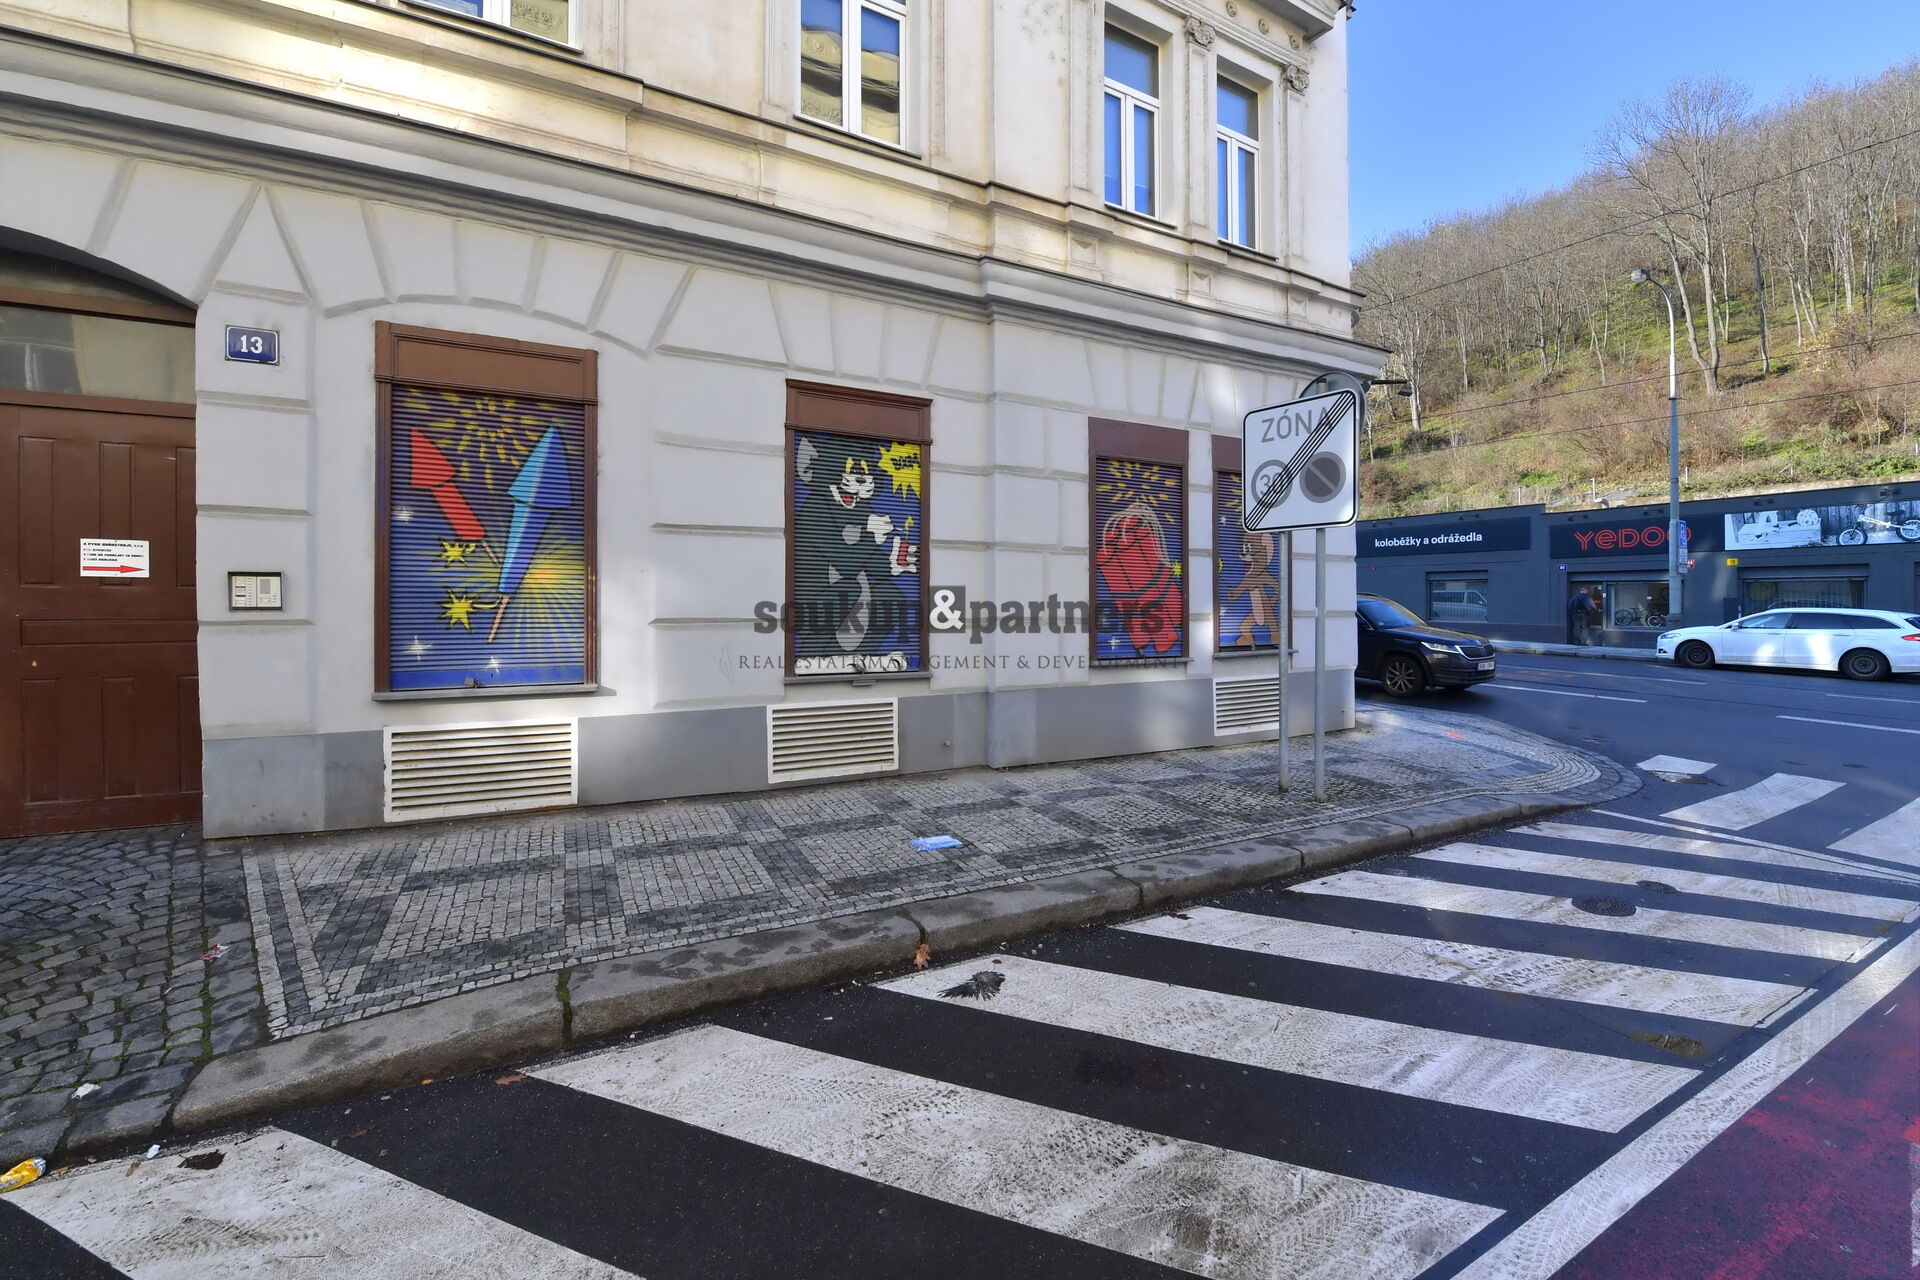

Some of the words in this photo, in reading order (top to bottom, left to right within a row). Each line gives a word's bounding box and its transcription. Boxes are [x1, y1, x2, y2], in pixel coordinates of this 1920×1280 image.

[240, 334, 263, 354] 13
[1374, 536, 1421, 548] koloběžky
[1423, 537, 1429, 545] a
[1431, 531, 1483, 545] odrážedla
